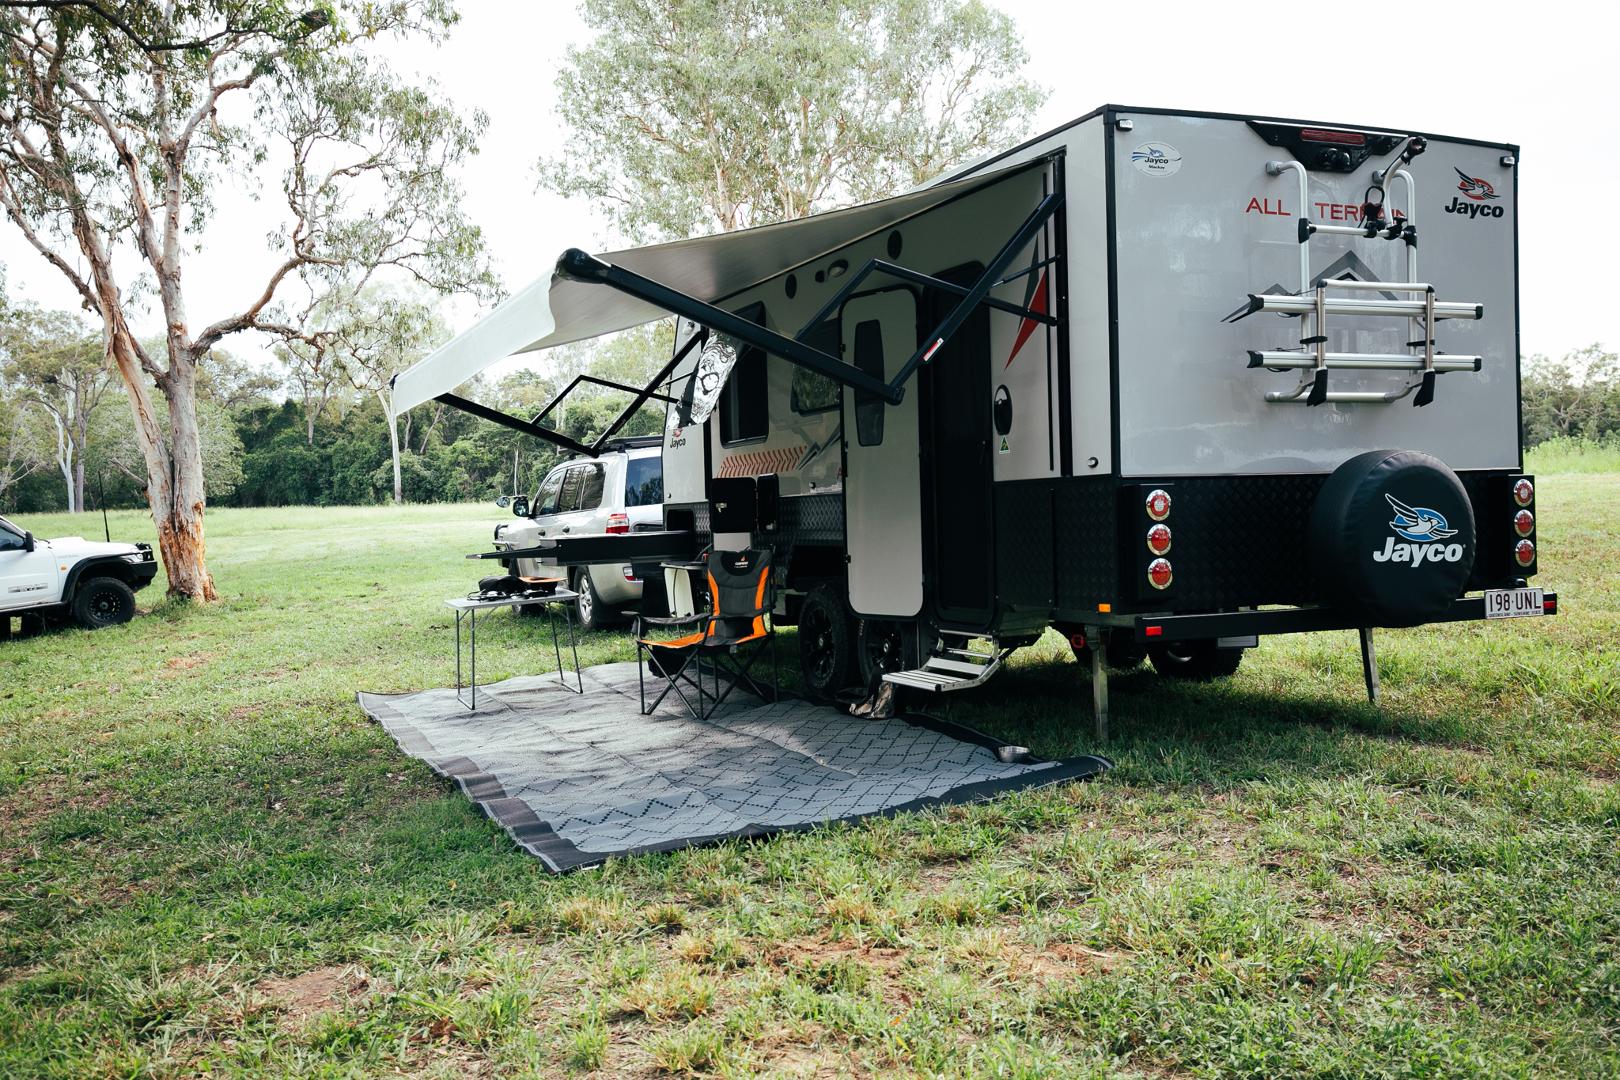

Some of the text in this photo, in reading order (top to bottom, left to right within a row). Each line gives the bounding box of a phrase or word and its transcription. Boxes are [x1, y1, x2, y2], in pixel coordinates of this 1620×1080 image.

[1144, 156, 1169, 165] Jayco
[1245, 197, 1291, 216] ALL
[1444, 196, 1504, 219] Jayco
[670, 437, 687, 450] Jayco
[1372, 536, 1463, 568] Jayco
